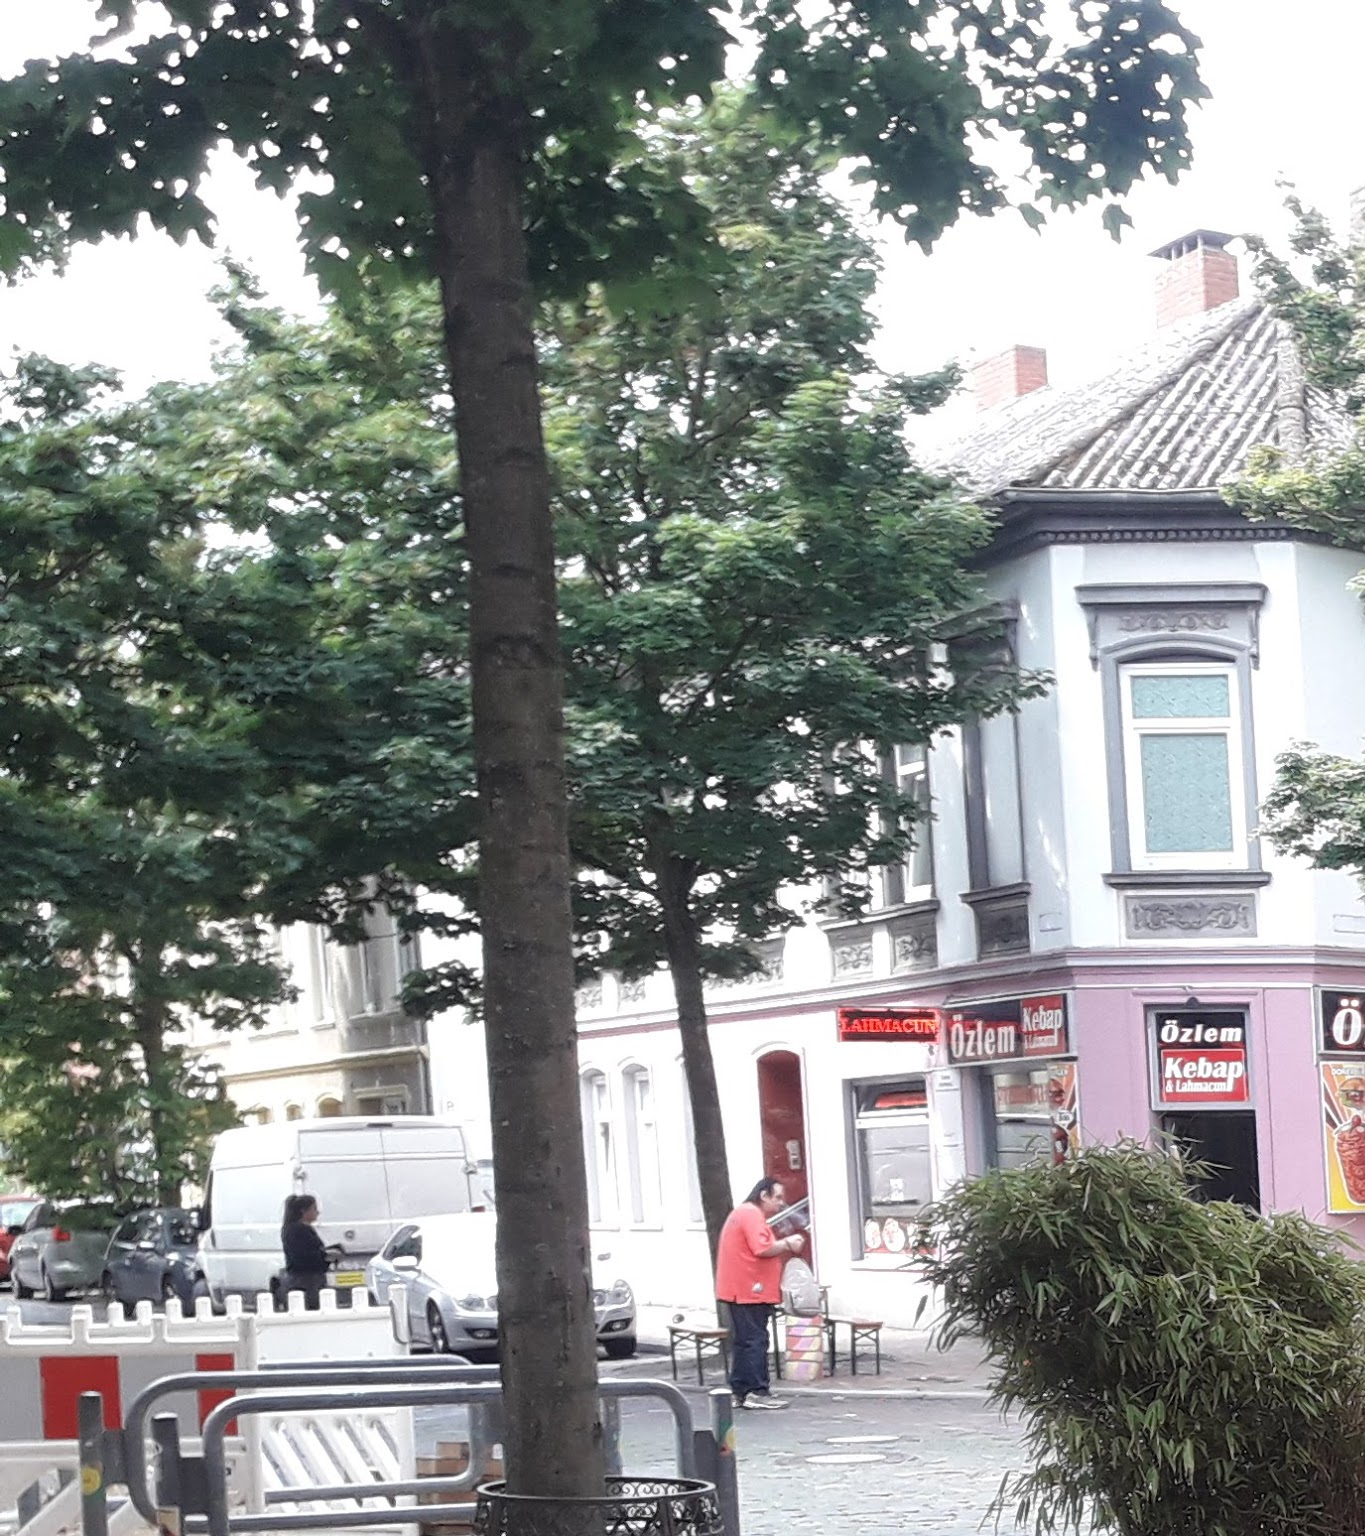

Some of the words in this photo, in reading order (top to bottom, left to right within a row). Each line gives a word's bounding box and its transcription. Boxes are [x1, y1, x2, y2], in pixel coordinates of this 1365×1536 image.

[840, 1017, 937, 1034] LAHMACUN
[951, 1013, 1015, 1058] Özlem
[1023, 1004, 1063, 1046] Kebap
[1161, 1020, 1242, 1043] Özlem
[1165, 1057, 1243, 1092] Kebap
[1165, 1080, 1173, 1093] &
